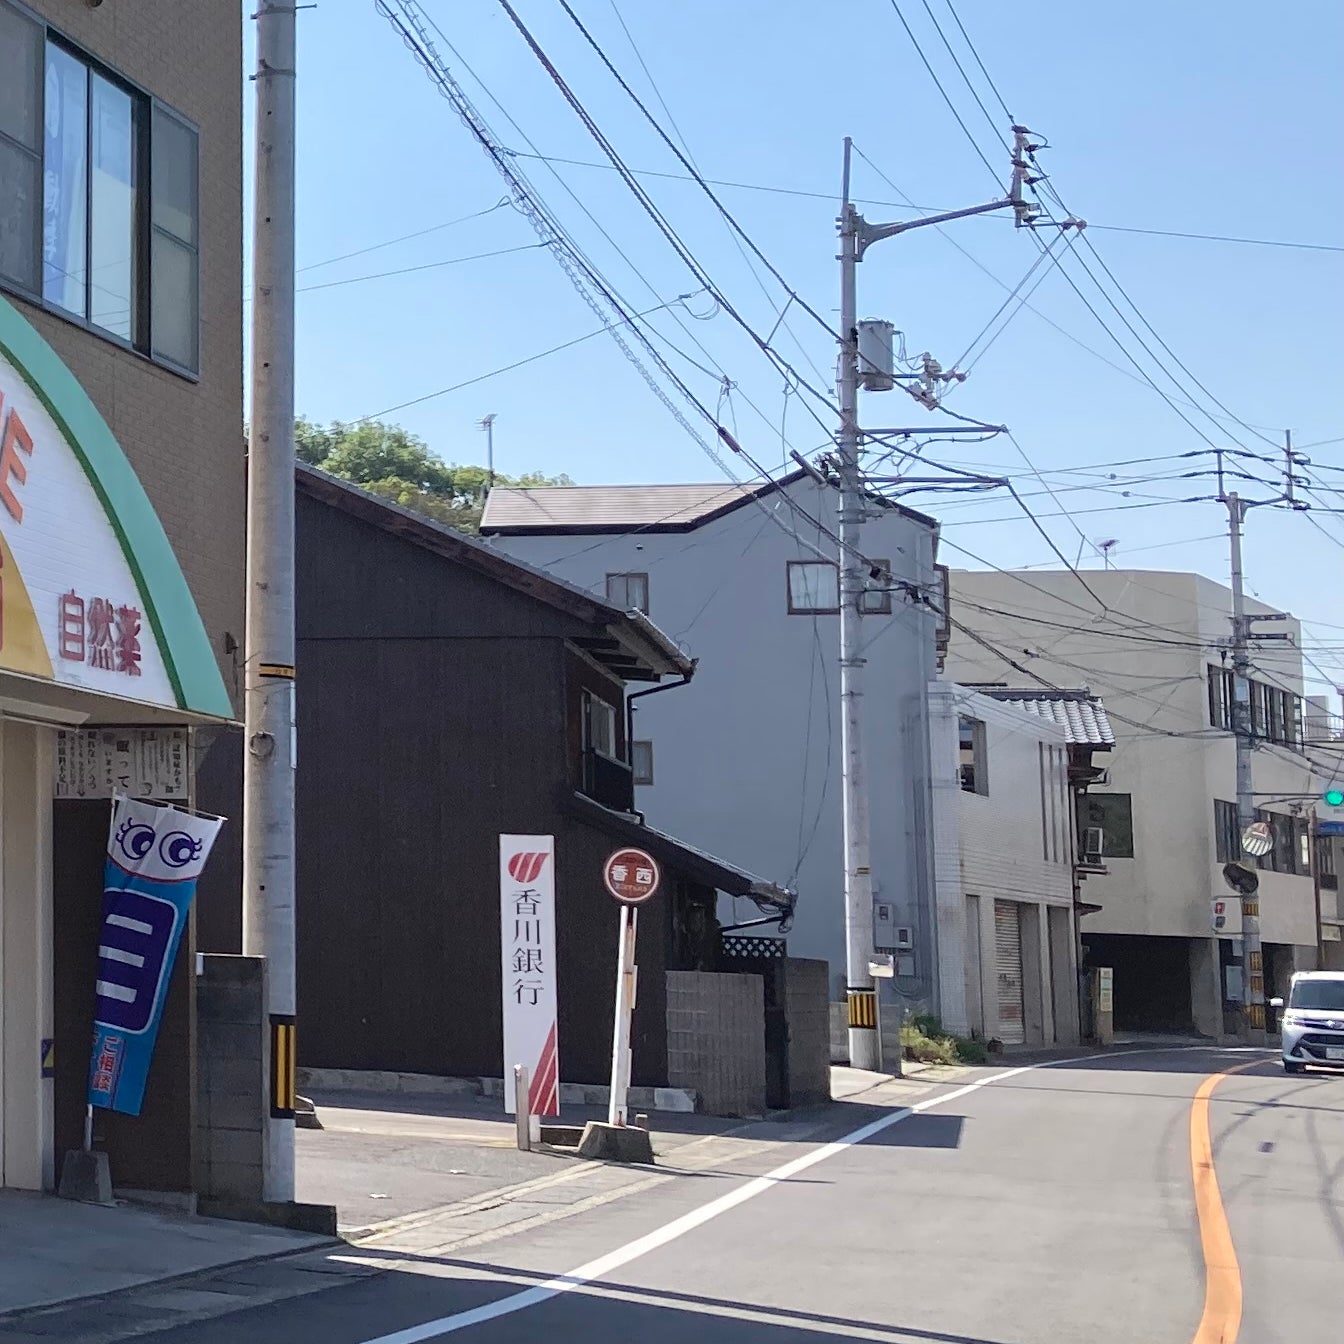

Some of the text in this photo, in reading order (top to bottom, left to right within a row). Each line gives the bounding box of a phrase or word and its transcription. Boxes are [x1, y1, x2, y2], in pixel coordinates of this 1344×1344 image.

[57, 588, 143, 677] 自然薬
[512, 888, 545, 1006] 香川銀行
